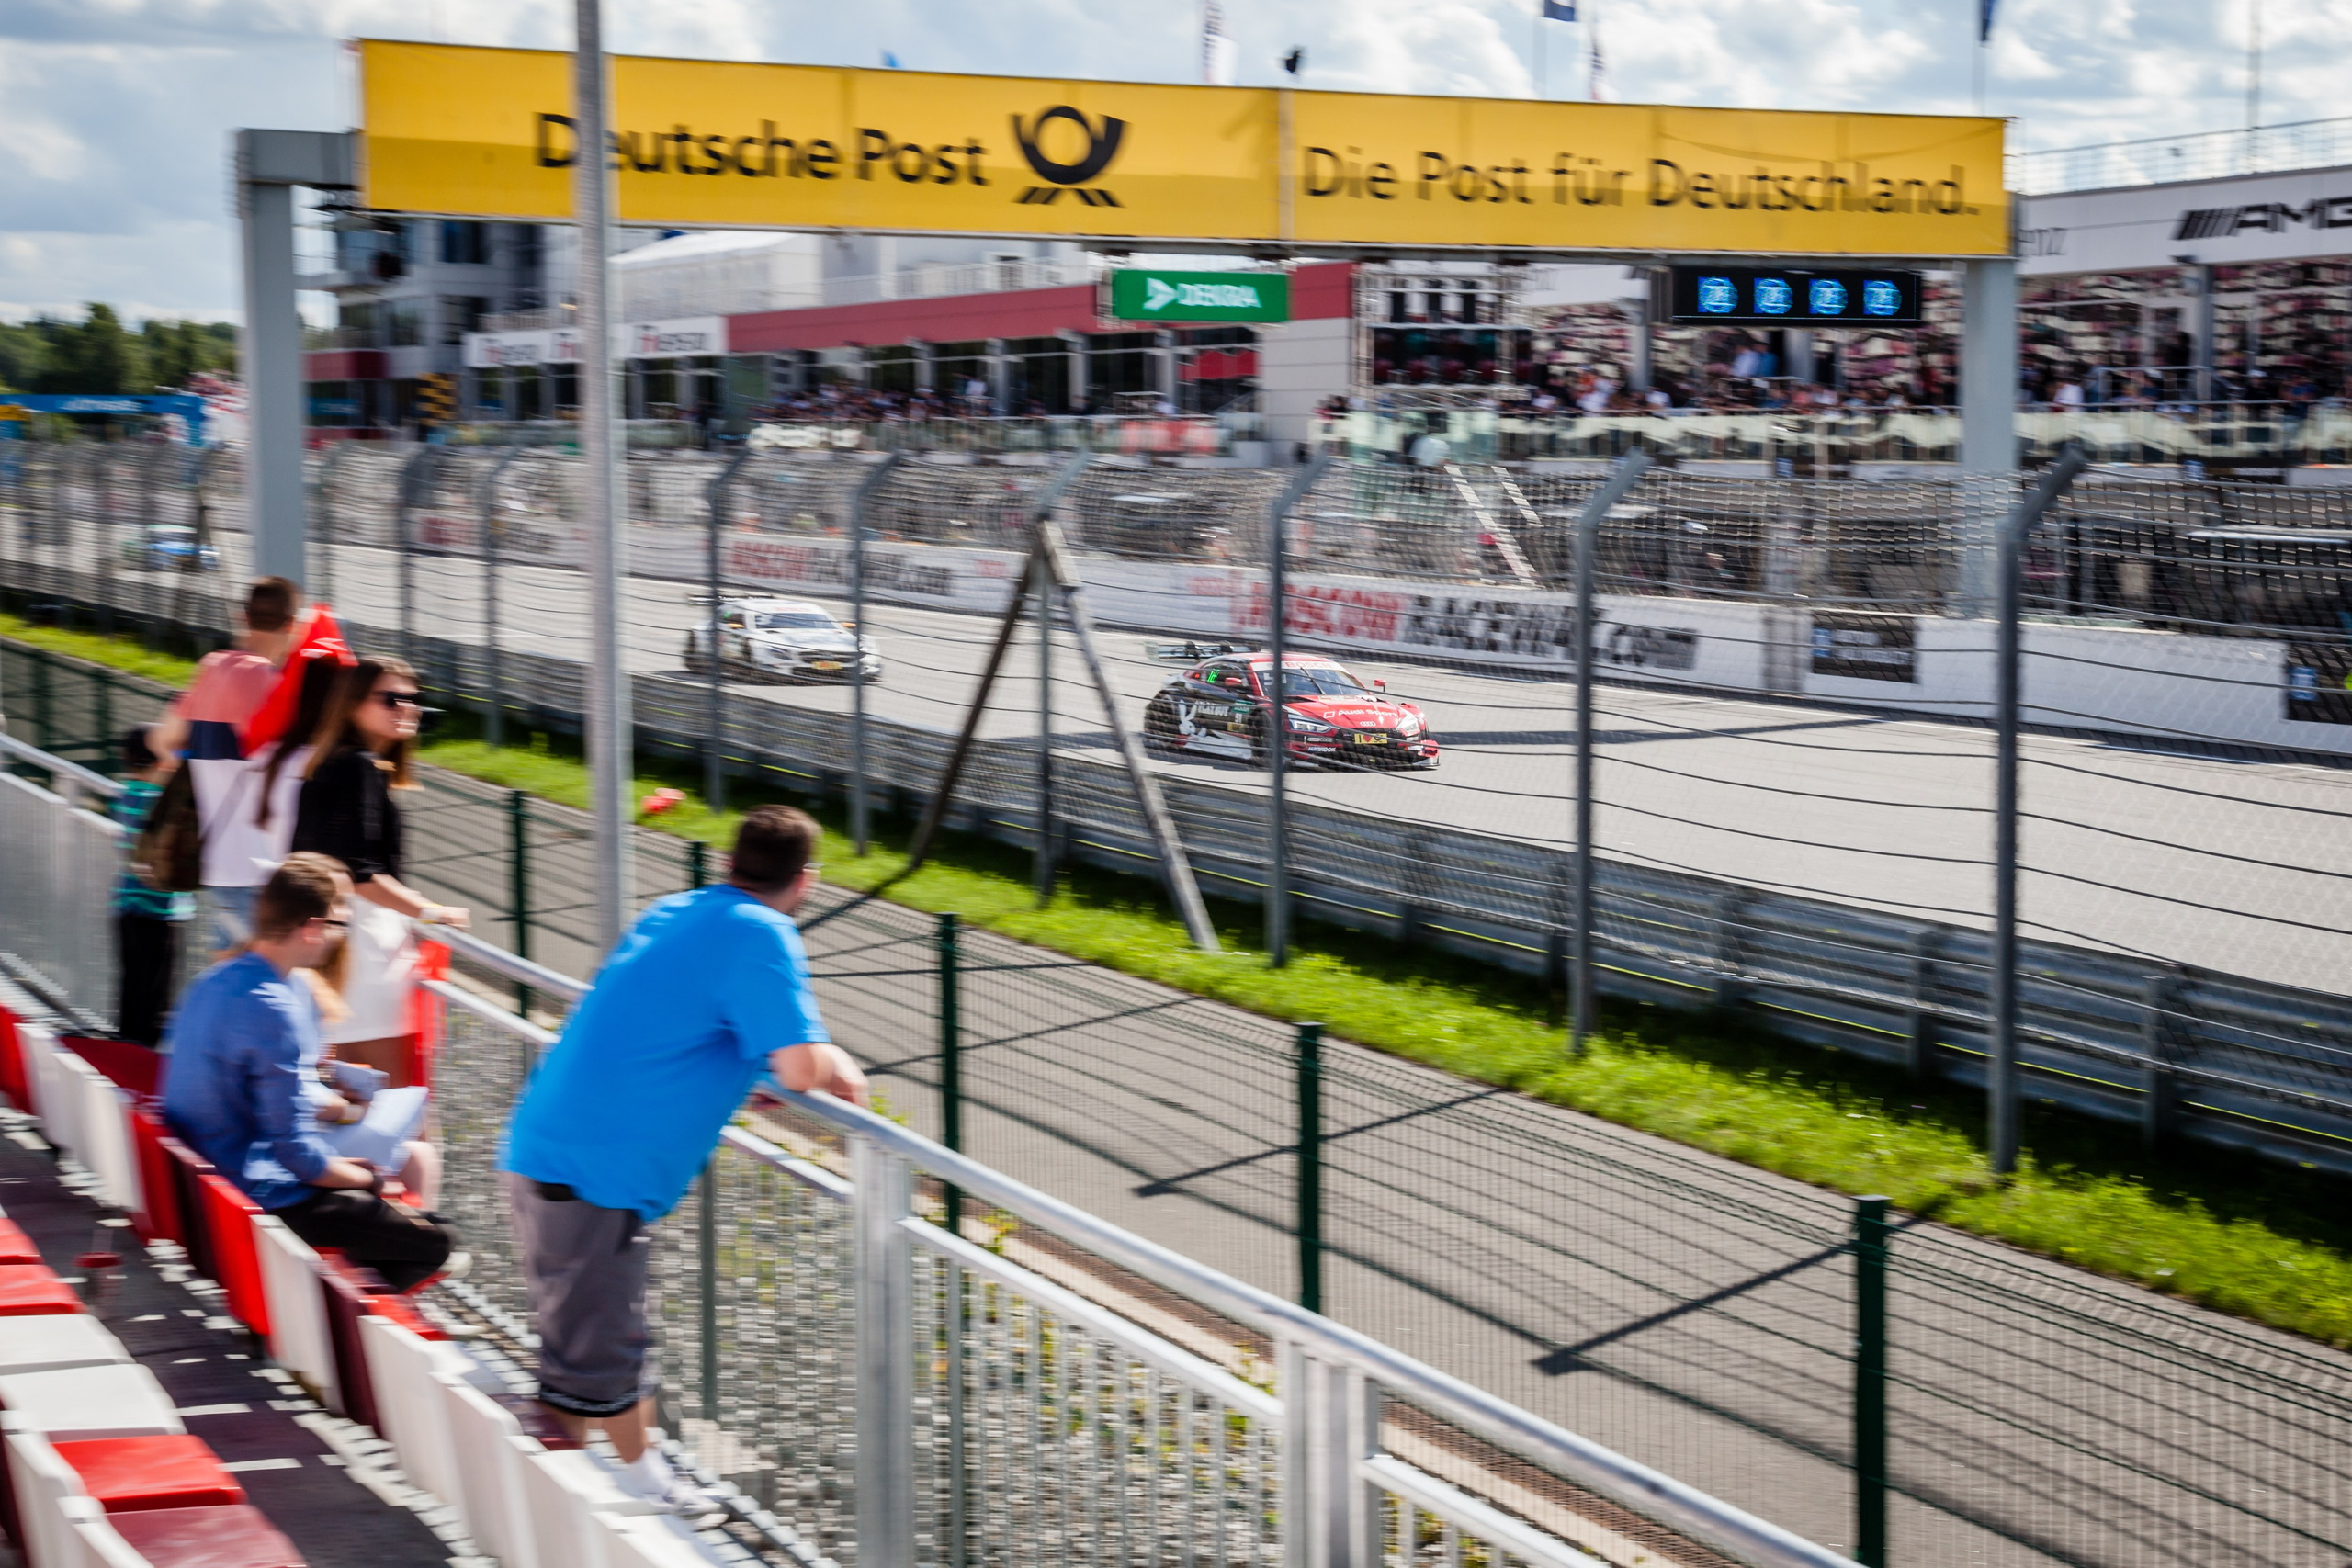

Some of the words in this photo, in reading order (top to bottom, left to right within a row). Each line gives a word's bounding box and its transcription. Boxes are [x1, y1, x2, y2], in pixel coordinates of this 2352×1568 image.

[854, 126, 990, 187] Post
[1304, 146, 1398, 200] Die
[1416, 151, 1533, 204] Post
[1549, 152, 1632, 207] für
[1649, 158, 1979, 216] Deutschland.
[1367, 709, 1398, 717] Sport
